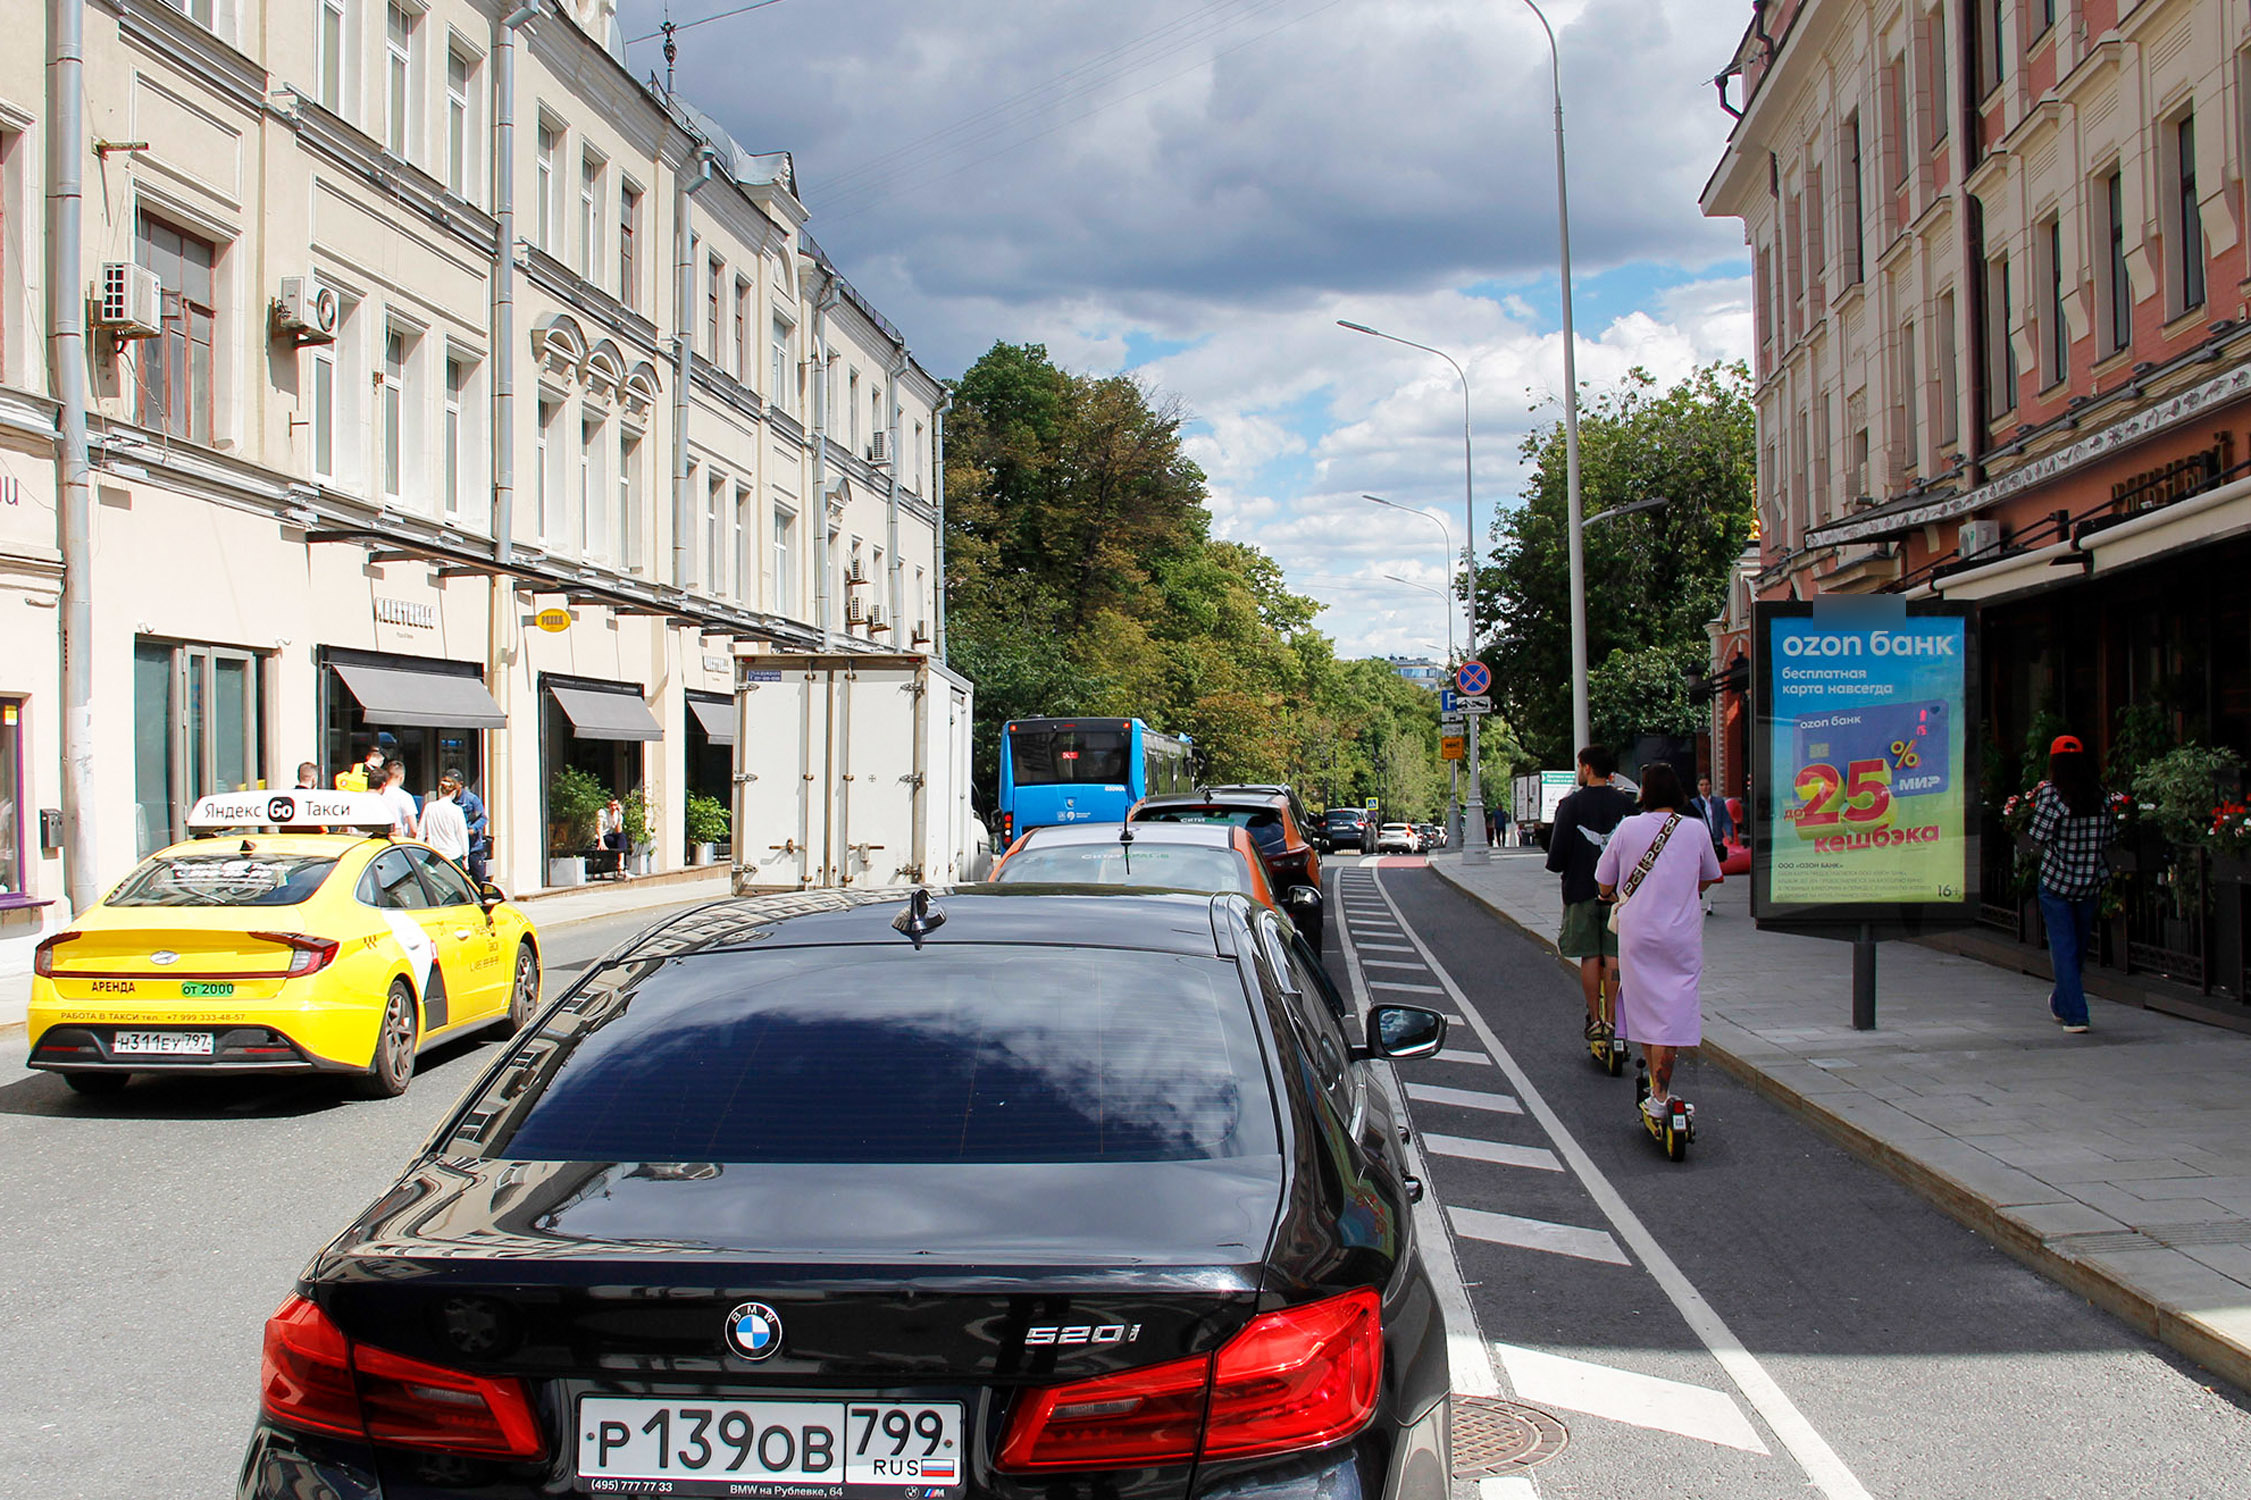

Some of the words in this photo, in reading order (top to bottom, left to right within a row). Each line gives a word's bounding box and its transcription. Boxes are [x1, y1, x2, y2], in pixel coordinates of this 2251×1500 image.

[1782, 635, 1862, 657] ozon
[1869, 630, 1954, 657] банк
[1782, 666, 1867, 680] бесплатная
[1782, 684, 1824, 697] карта
[1828, 684, 1894, 696] навсегда
[1800, 719, 1829, 729] ozon
[1831, 715, 1862, 726] банк
[1899, 775, 1941, 791] МИР
[1794, 758, 1896, 834] 25
[205, 803, 261, 819] Яндекс
[268, 799, 295, 819] Go
[305, 801, 351, 817] Такси
[1814, 823, 1940, 854] кешбэка
[91, 981, 136, 993] АРЕНДА
[182, 984, 198, 995] от
[201, 983, 234, 995] 2000
[60, 1012, 97, 1020] РАБОТА
[109, 1013, 139, 1021] ТАКСИ
[120, 1033, 181, 1051] Н311ЕУ
[185, 1034, 208, 1047] 797
[731, 1305, 775, 1324] BMW
[1024, 1324, 1142, 1345] 520i
[599, 1408, 835, 1473] Р139ОВ
[850, 1408, 944, 1457] 799
[873, 1458, 920, 1476] RUS
[591, 1478, 619, 1492] (495)
[621, 1481, 642, 1492] 777
[643, 1481, 658, 1493] 77
[658, 1482, 673, 1493] 33
[729, 1485, 757, 1495] BMW
[759, 1486, 773, 1496] на
[774, 1485, 828, 1498] Рублевке,
[829, 1486, 844, 1498] 64
